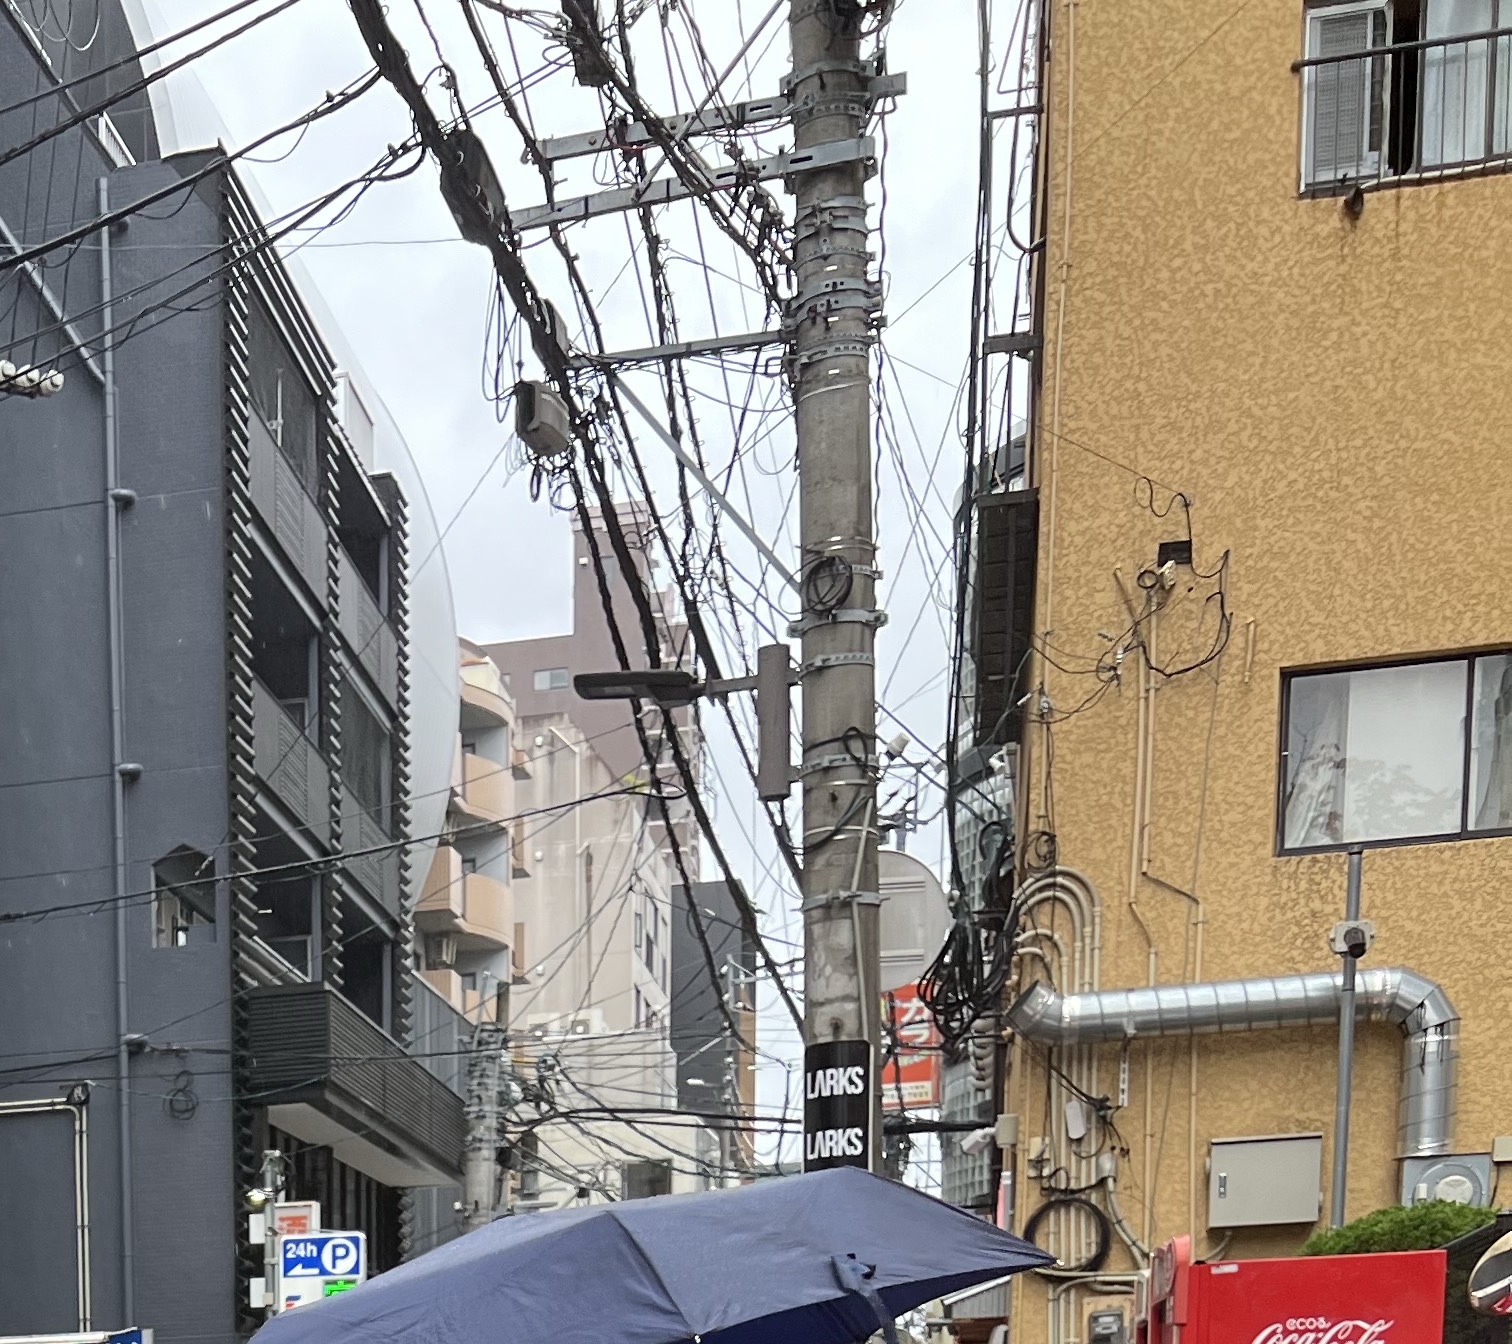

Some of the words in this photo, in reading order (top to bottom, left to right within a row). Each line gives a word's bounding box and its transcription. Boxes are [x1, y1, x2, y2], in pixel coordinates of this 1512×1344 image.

[806, 1066, 864, 1099] LARKS
[806, 1127, 863, 1160] LARKS
[285, 1242, 318, 1258] 24h
